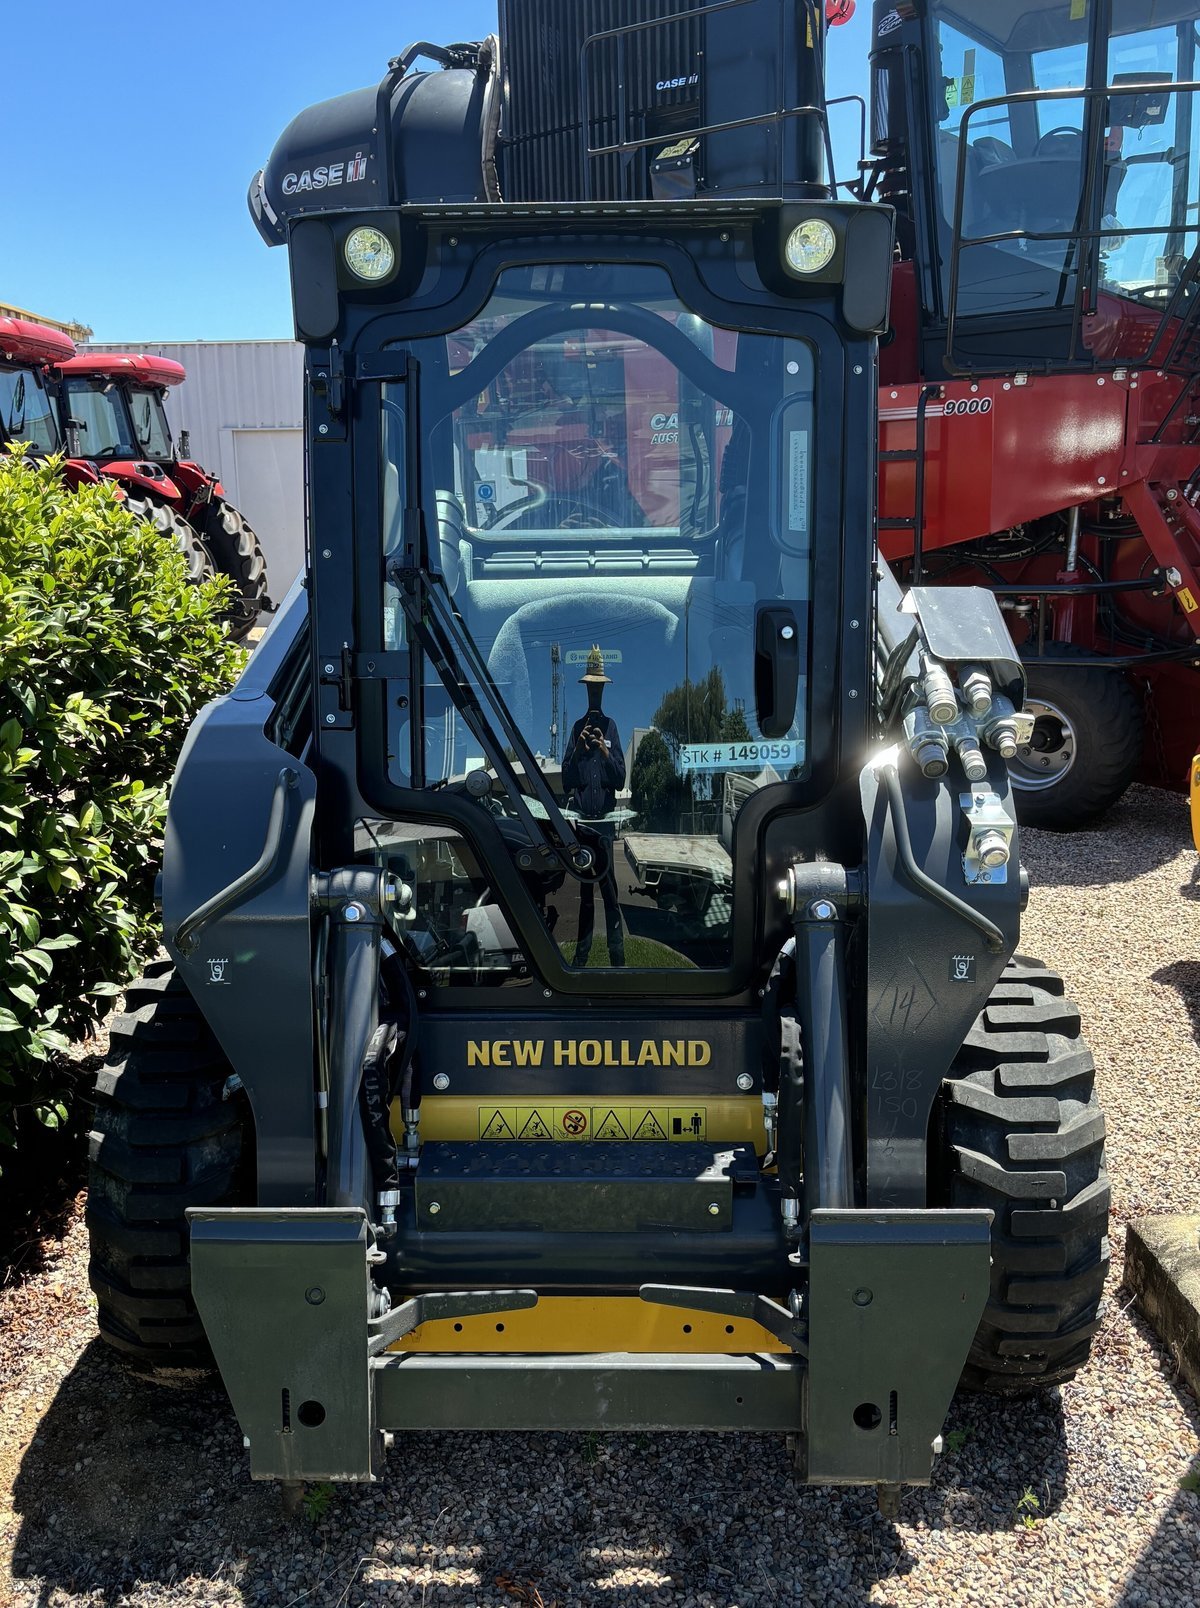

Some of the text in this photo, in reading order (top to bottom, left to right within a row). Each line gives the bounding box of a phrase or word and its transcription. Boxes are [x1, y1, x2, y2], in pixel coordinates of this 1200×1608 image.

[656, 77, 687, 90] CASE
[281, 162, 345, 195] CASE
[943, 396, 993, 416] 9000
[650, 412, 679, 431] CA
[682, 743, 791, 764] STK # 149059
[889, 984, 918, 1031] 14
[466, 1039, 712, 1067] NEW HOLLAND
